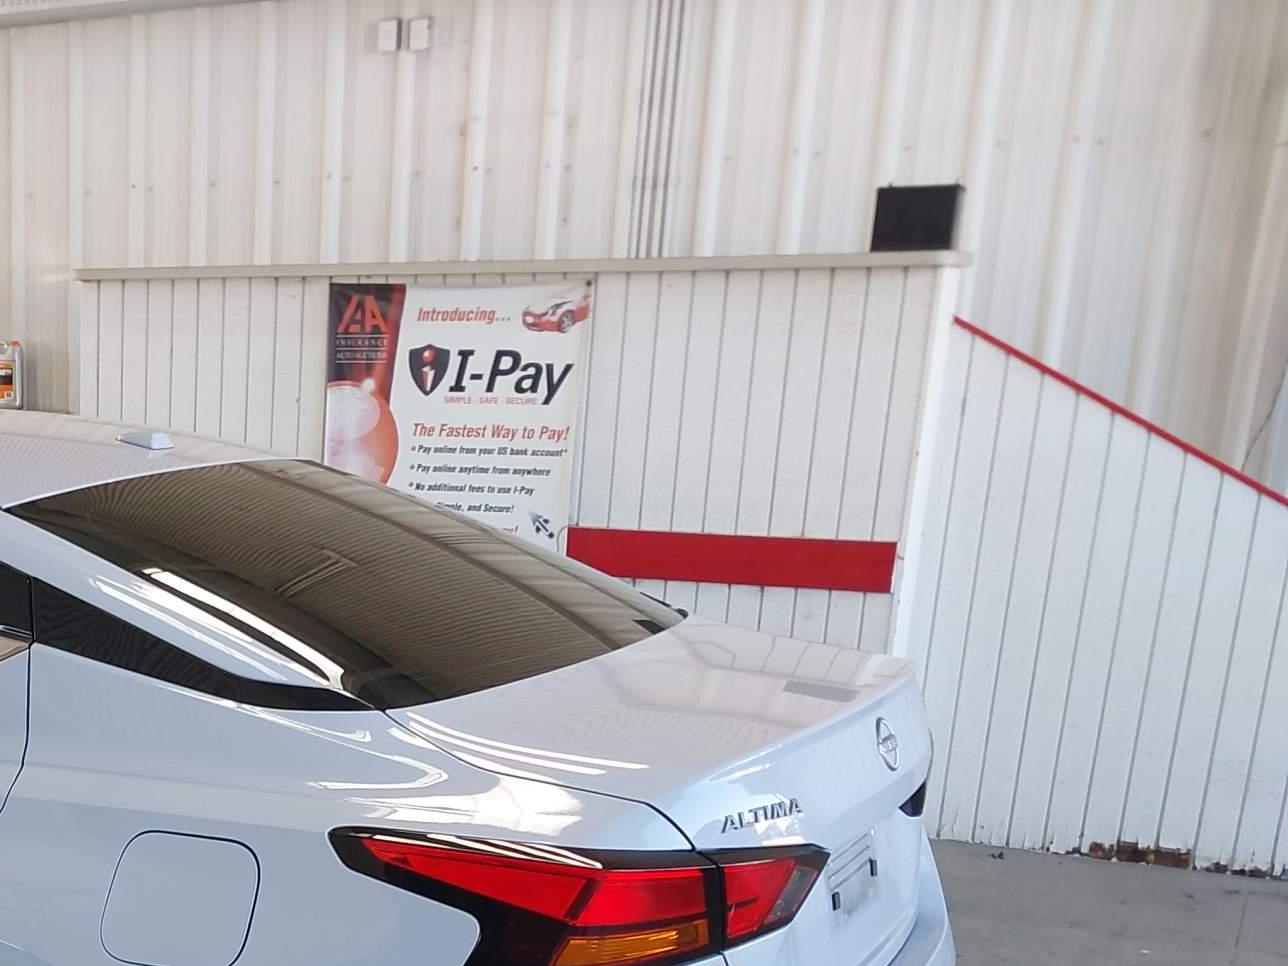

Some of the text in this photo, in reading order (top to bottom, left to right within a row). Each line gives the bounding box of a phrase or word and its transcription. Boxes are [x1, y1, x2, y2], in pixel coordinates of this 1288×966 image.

[417, 306, 511, 325] Introducing...
[449, 349, 575, 406] I-Pay
[443, 396, 537, 405] SIMPLE SAFE SECURE
[412, 422, 570, 443] The Fastest Way to Pay!
[417, 444, 432, 455] Pay
[433, 445, 457, 454] online
[459, 445, 477, 454] from
[478, 447, 496, 456] your
[497, 447, 508, 455] US
[509, 447, 528, 455] bank
[416, 463, 551, 477] Pay online anytime from anywhere
[415, 482, 425, 491] No
[426, 482, 467, 492] additional
[468, 484, 485, 493] fees
[487, 485, 495, 494] to
[513, 486, 535, 496] I-Pay
[467, 503, 483, 512] and
[483, 503, 515, 513] Secure!
[720, 798, 803, 834] ALTIMA
